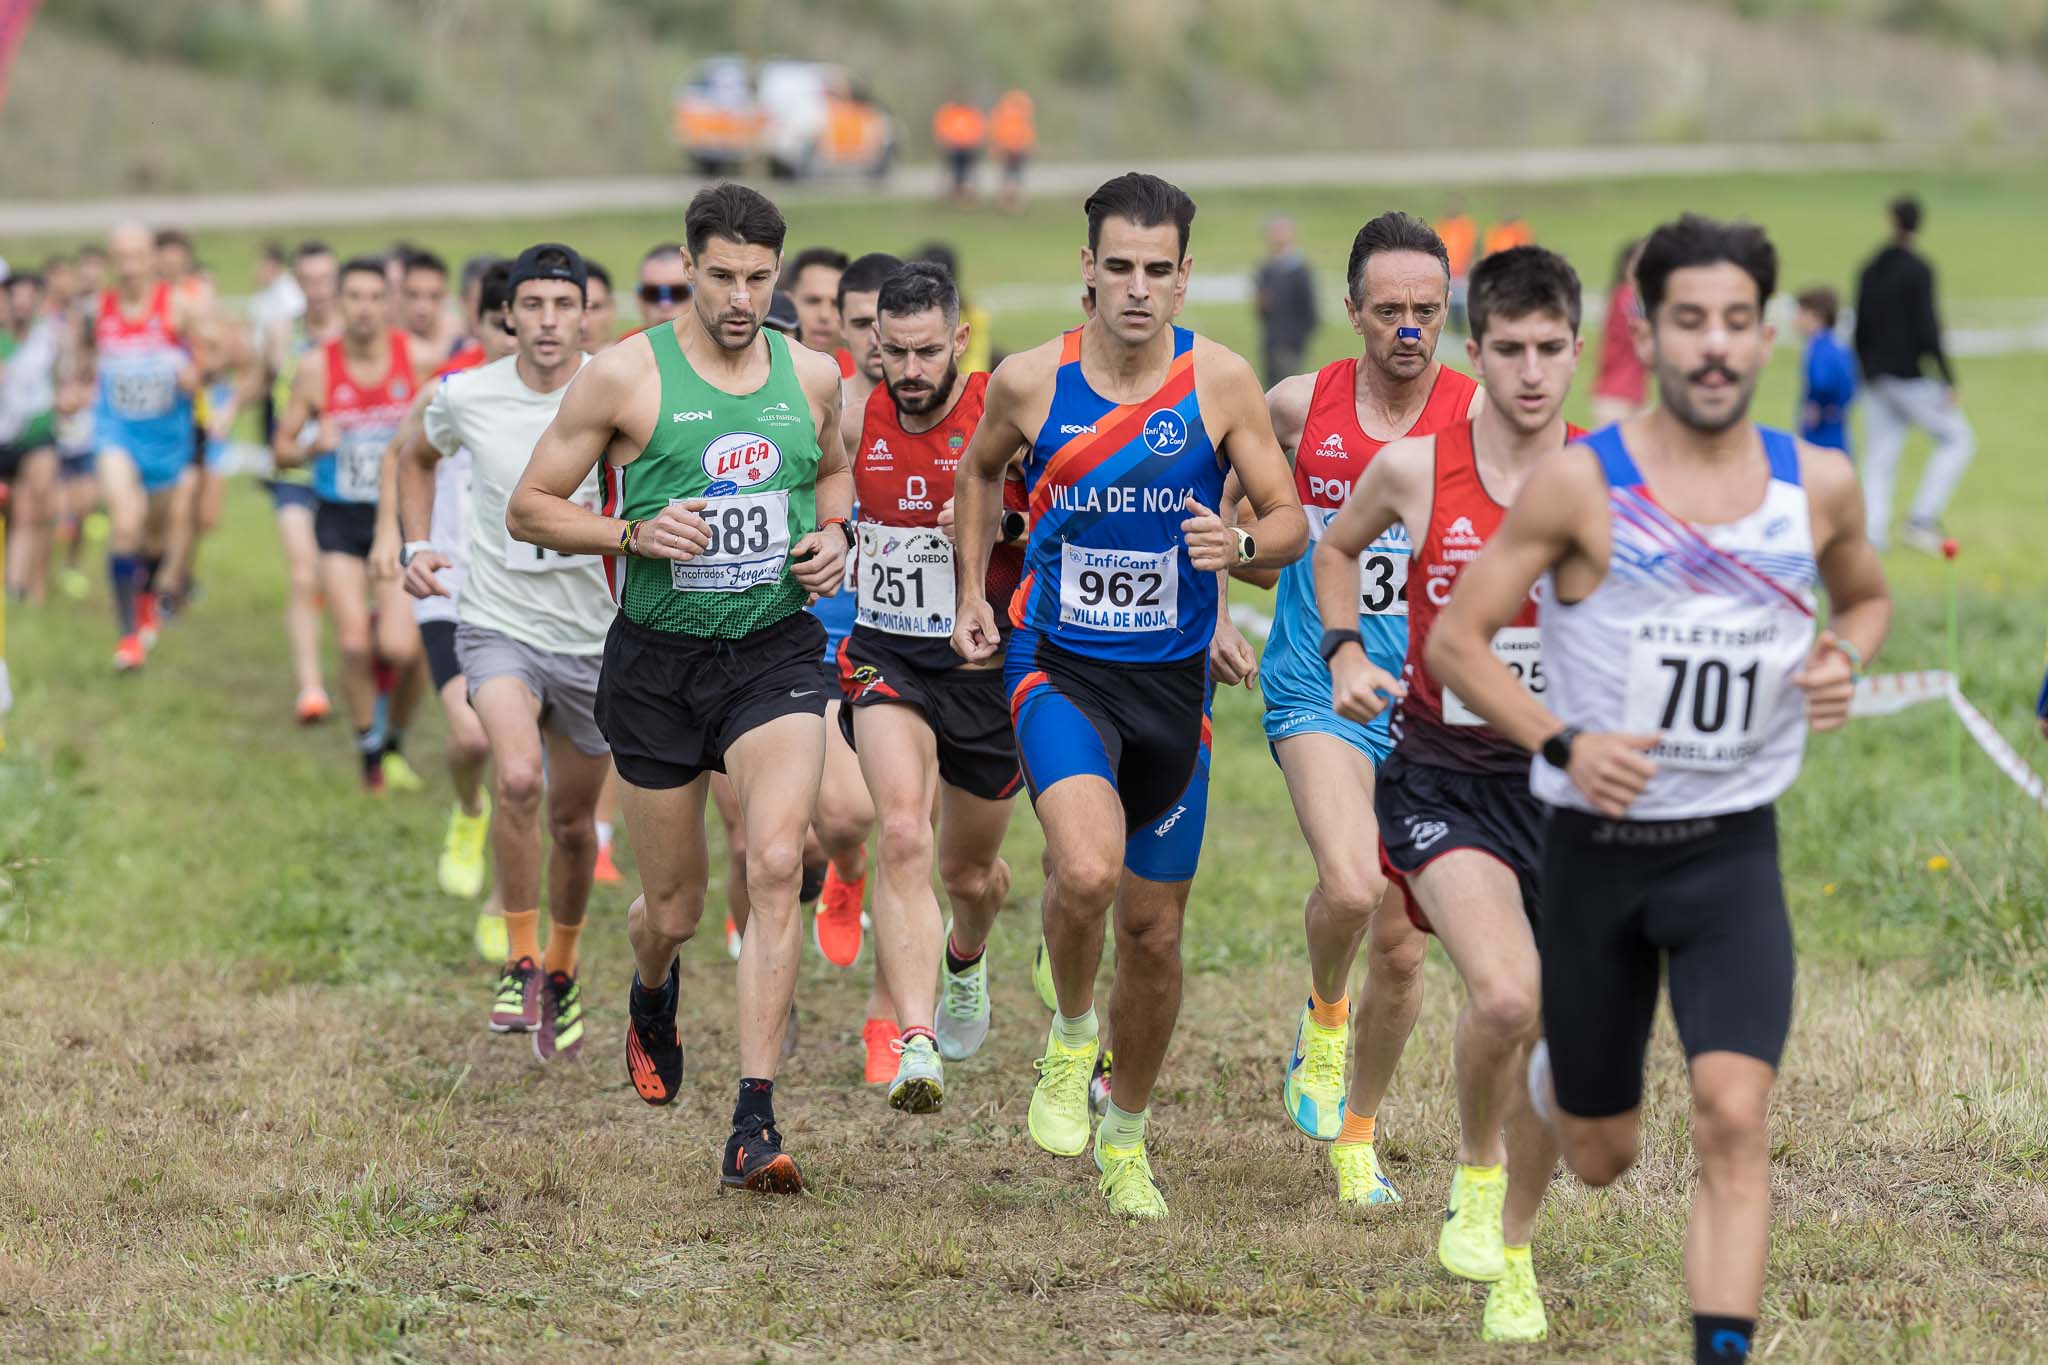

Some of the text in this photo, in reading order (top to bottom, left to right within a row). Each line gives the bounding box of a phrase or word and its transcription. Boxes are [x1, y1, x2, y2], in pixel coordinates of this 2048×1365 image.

[717, 442, 769, 475] LUCA
[898, 498, 933, 510] Beco
[1048, 483, 1194, 513] VILLA DE NOJA
[700, 505, 769, 557] 583
[907, 554, 949, 564] LOREDO
[1084, 552, 1158, 570] InfiCant
[674, 567, 725, 580] Encofrados
[871, 562, 924, 609] 251
[1078, 571, 1163, 608] 962
[859, 606, 952, 633] RIBMONTÁN AL MAR
[1072, 607, 1168, 628] VILLA DE NOJA
[1660, 656, 1760, 733] 701
